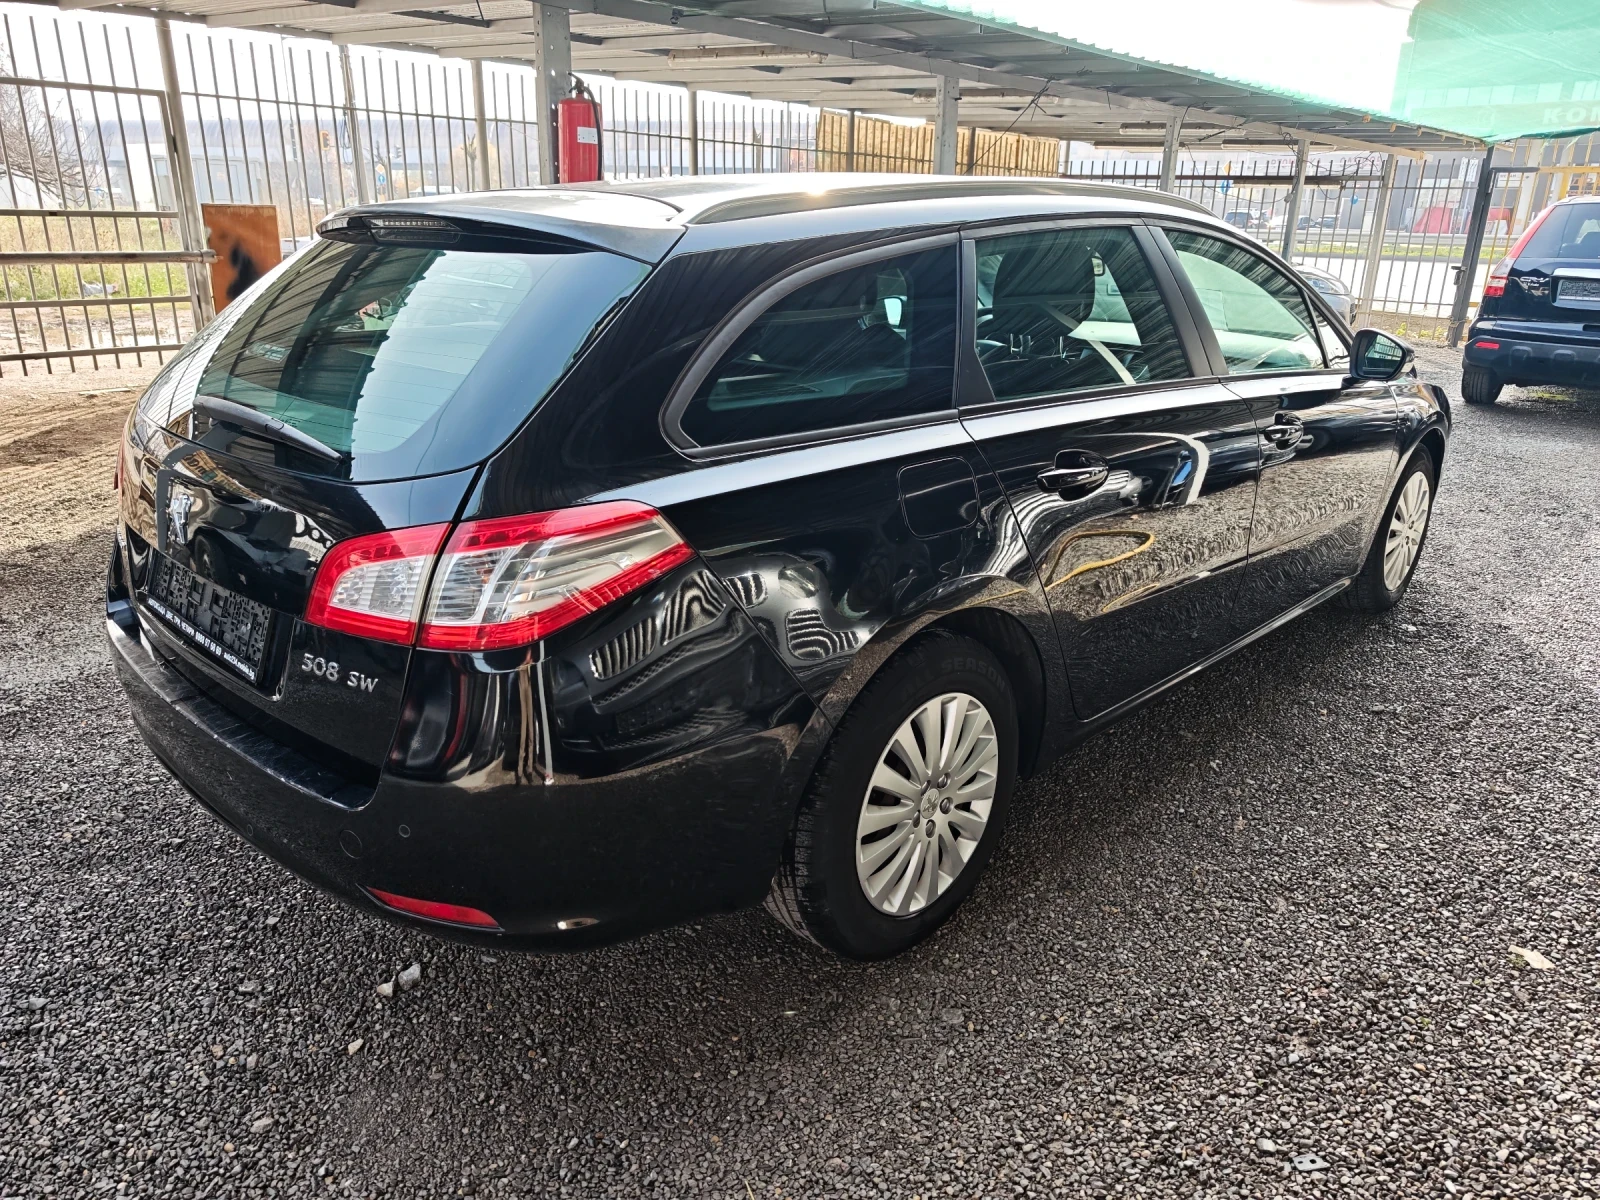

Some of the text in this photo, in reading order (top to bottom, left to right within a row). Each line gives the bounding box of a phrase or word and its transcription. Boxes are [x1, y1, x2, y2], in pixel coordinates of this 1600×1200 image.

[301, 652, 379, 693] 508 SW
[941, 657, 1005, 691] SEASON
